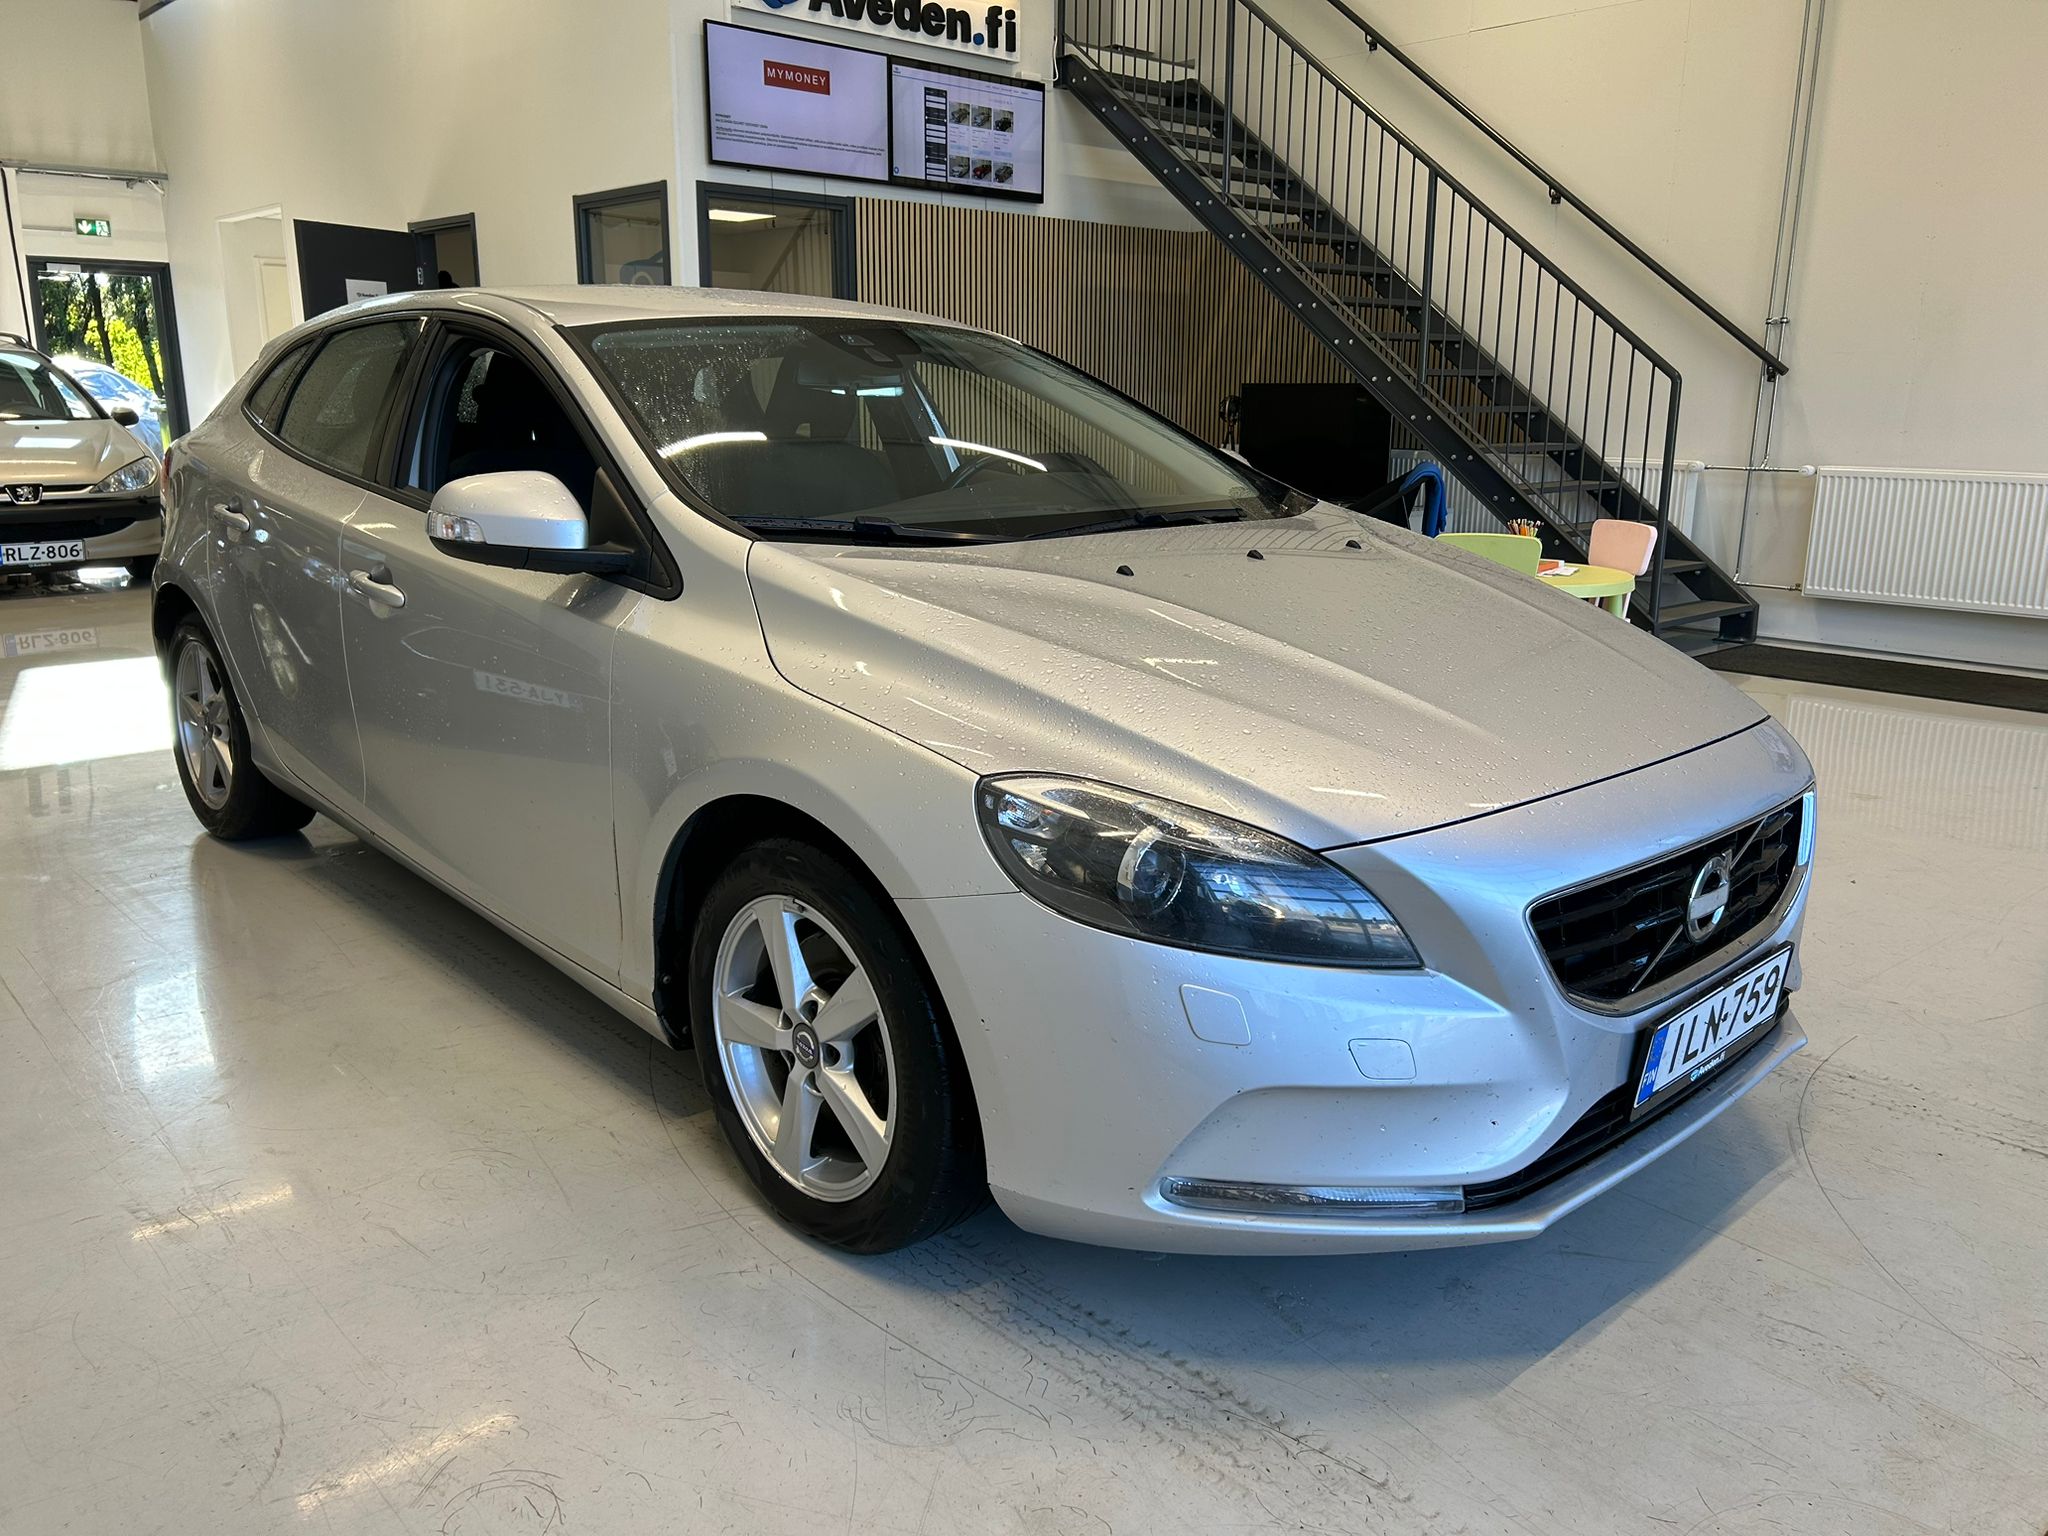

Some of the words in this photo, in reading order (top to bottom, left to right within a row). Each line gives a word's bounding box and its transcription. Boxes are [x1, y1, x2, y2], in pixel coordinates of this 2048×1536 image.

[767, 67, 826, 86] MYMONEY
[5, 544, 80, 562] RLZ-806
[1668, 965, 1780, 1074] ILN-759
[1641, 1066, 1659, 1088] FIN
